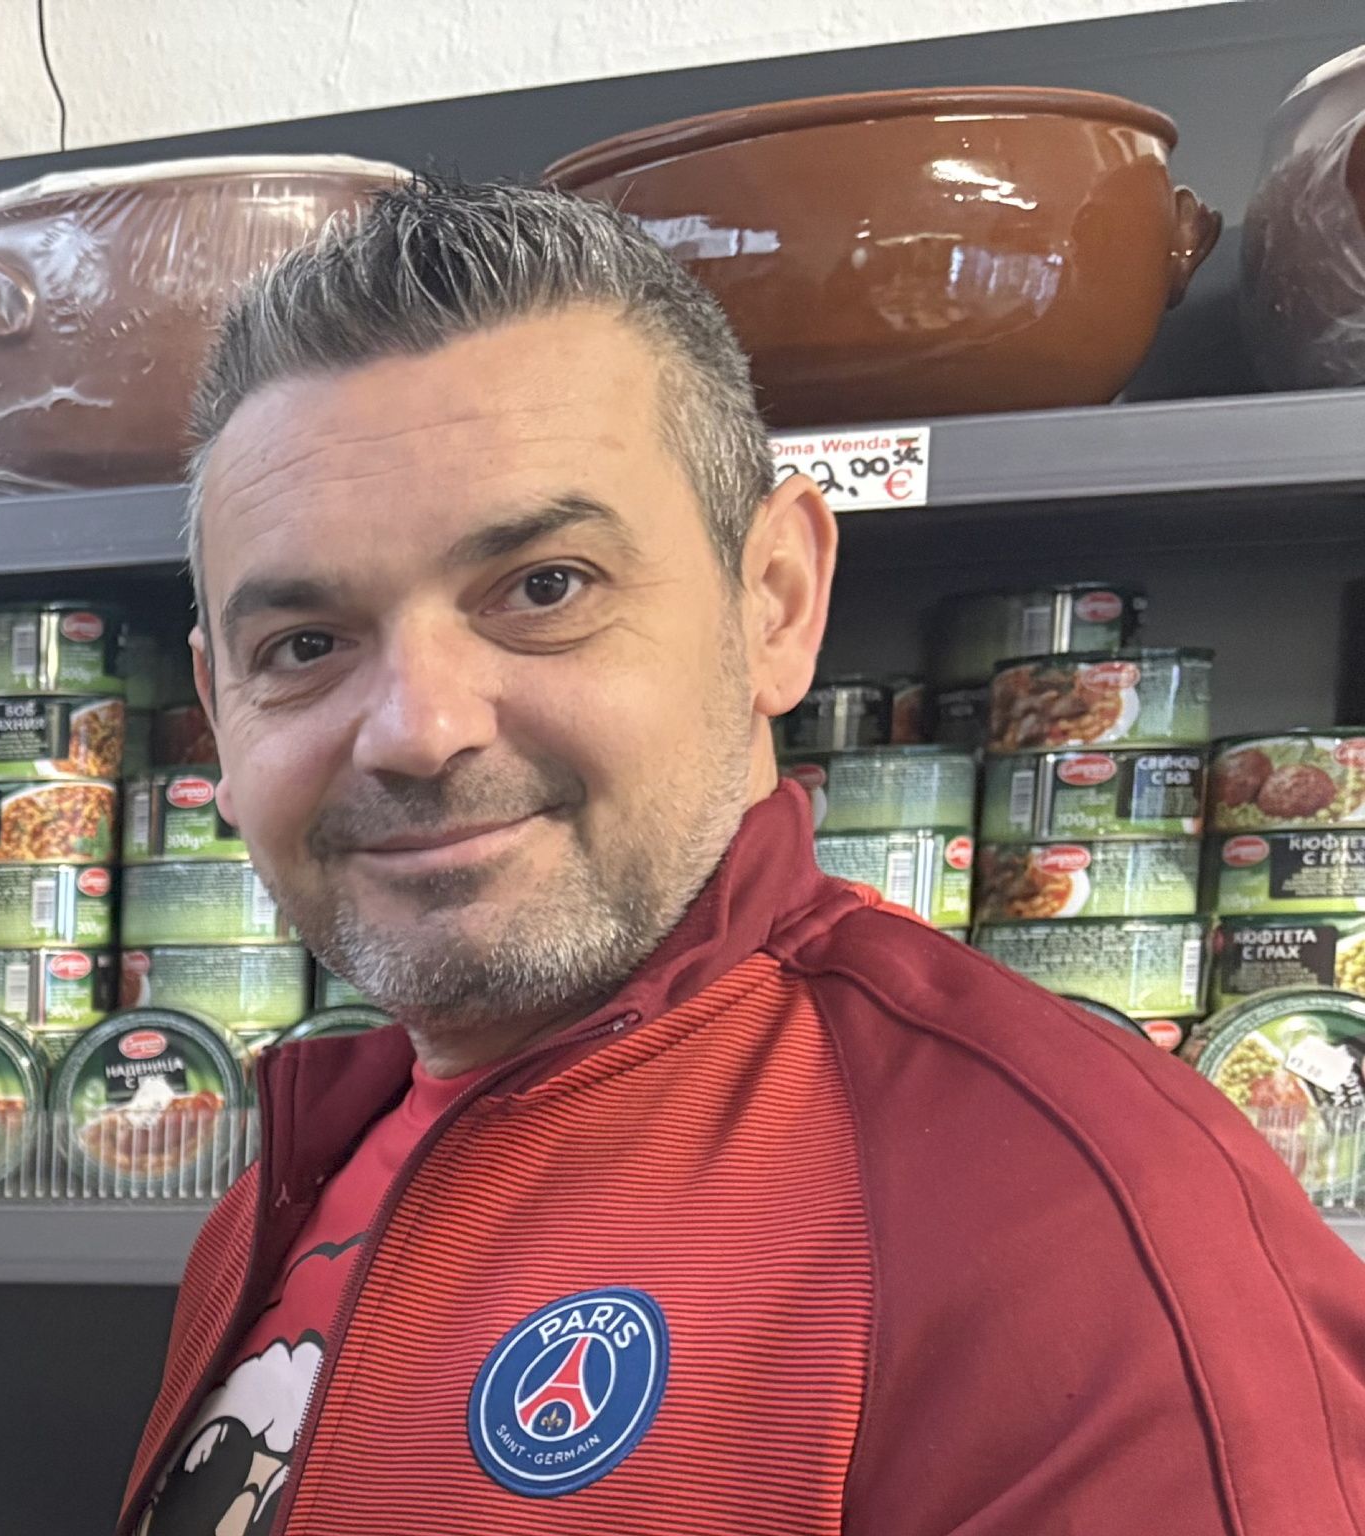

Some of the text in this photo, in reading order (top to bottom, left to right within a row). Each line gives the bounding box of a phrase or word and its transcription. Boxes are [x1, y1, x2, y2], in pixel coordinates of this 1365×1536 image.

[821, 436, 891, 455] Wenda
[883, 469, 913, 500] €
[1233, 929, 1318, 945] КЮФТЕТА
[1256, 945, 1302, 960] ГРАХ
[537, 1305, 641, 1349] PARIS
[496, 1424, 602, 1466] SAINT GERMAIN
